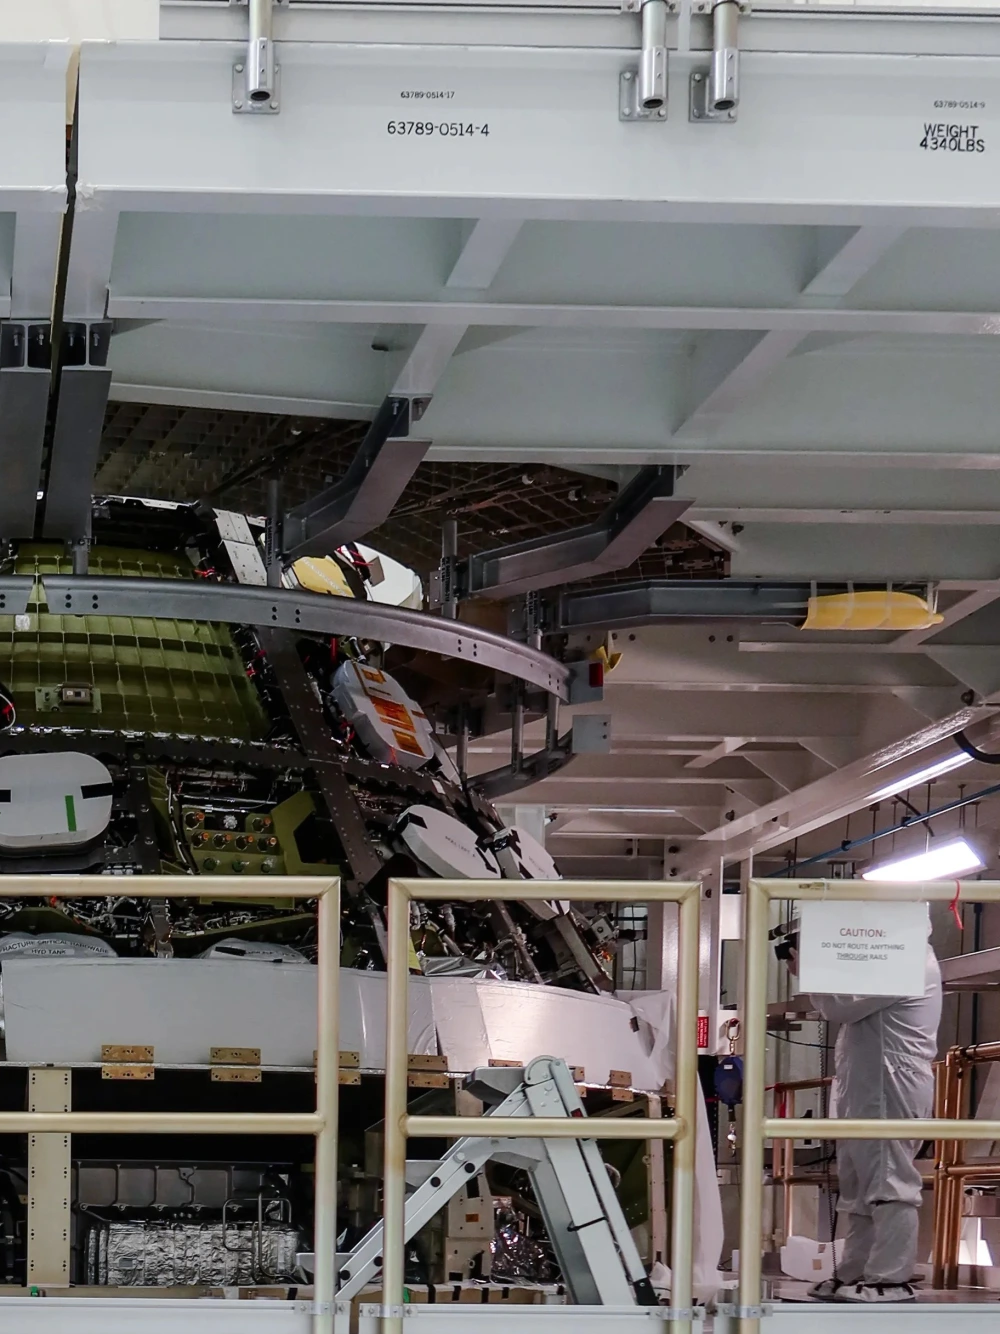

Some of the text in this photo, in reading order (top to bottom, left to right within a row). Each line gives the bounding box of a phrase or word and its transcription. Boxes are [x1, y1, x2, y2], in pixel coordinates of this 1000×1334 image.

[401, 91, 455, 99] 63789-0514-17
[387, 120, 490, 137] 63789-0514-4
[924, 122, 979, 138] WEIGHT
[919, 136, 985, 152] 4340LBS
[839, 928, 887, 938] CAUTION:
[836, 952, 869, 961] THROUGH
